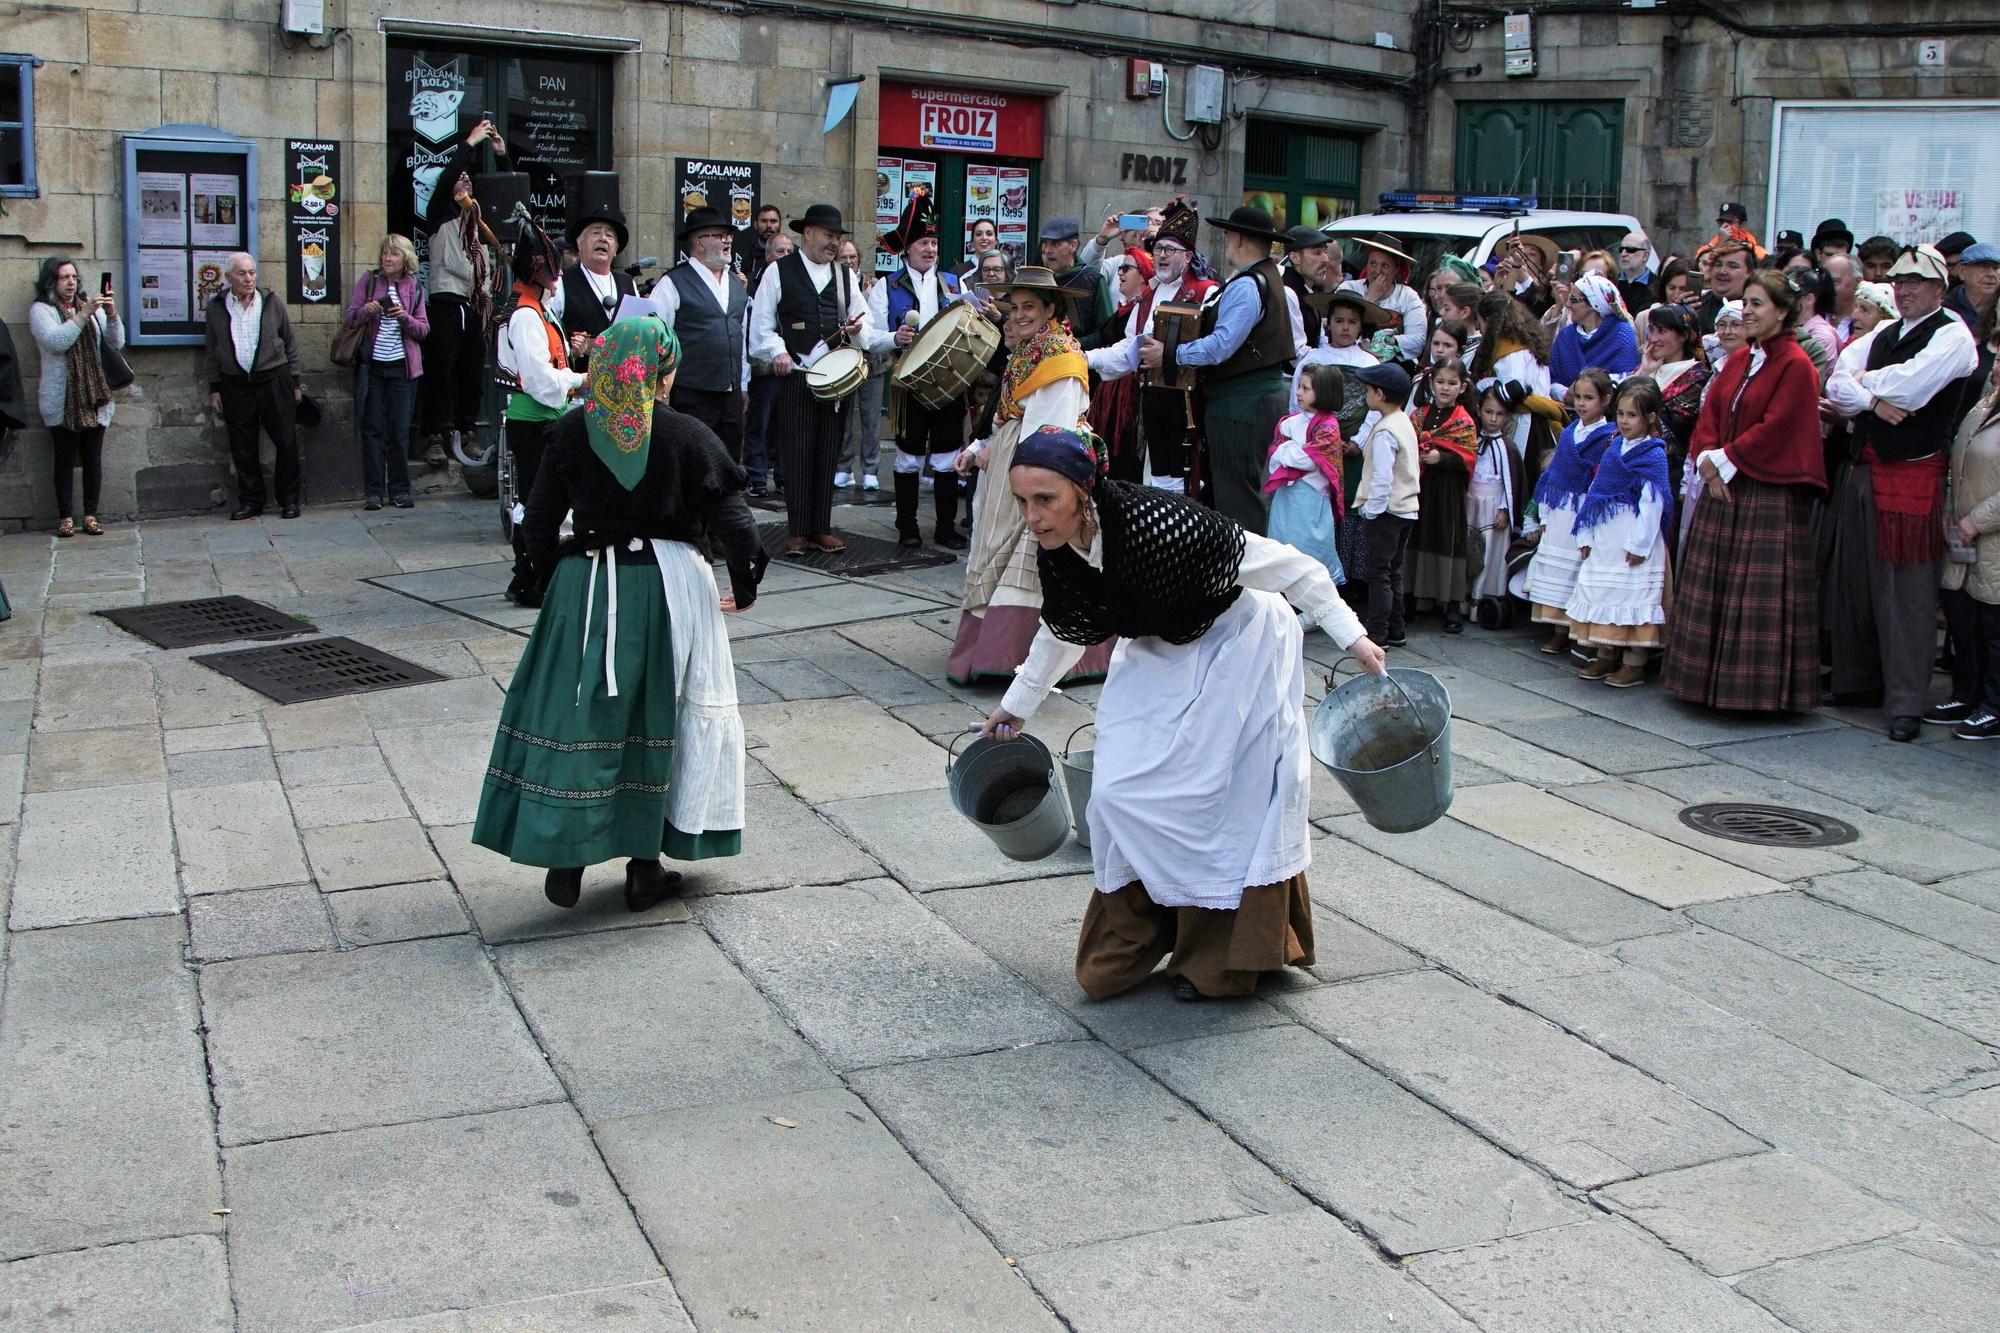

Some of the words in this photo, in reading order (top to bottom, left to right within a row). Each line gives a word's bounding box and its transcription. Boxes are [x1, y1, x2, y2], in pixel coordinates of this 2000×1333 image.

[405, 68, 465, 87] BOCALAMAR
[421, 78, 450, 89] ROLO
[539, 75, 567, 92] PAN
[911, 88, 1007, 108] supermercado
[924, 106, 994, 137] FROIZ
[291, 141, 334, 151] BOCALAMAR
[935, 136, 958, 146] Siempre
[970, 140, 993, 149] servicio
[406, 153, 452, 168] BOCALAM
[1121, 152, 1189, 185] FROIZ
[687, 161, 752, 178] BOCALAMAR
[530, 193, 566, 208] ALAM
[1879, 188, 1899, 209] SE
[1904, 188, 1959, 209] VENDE
